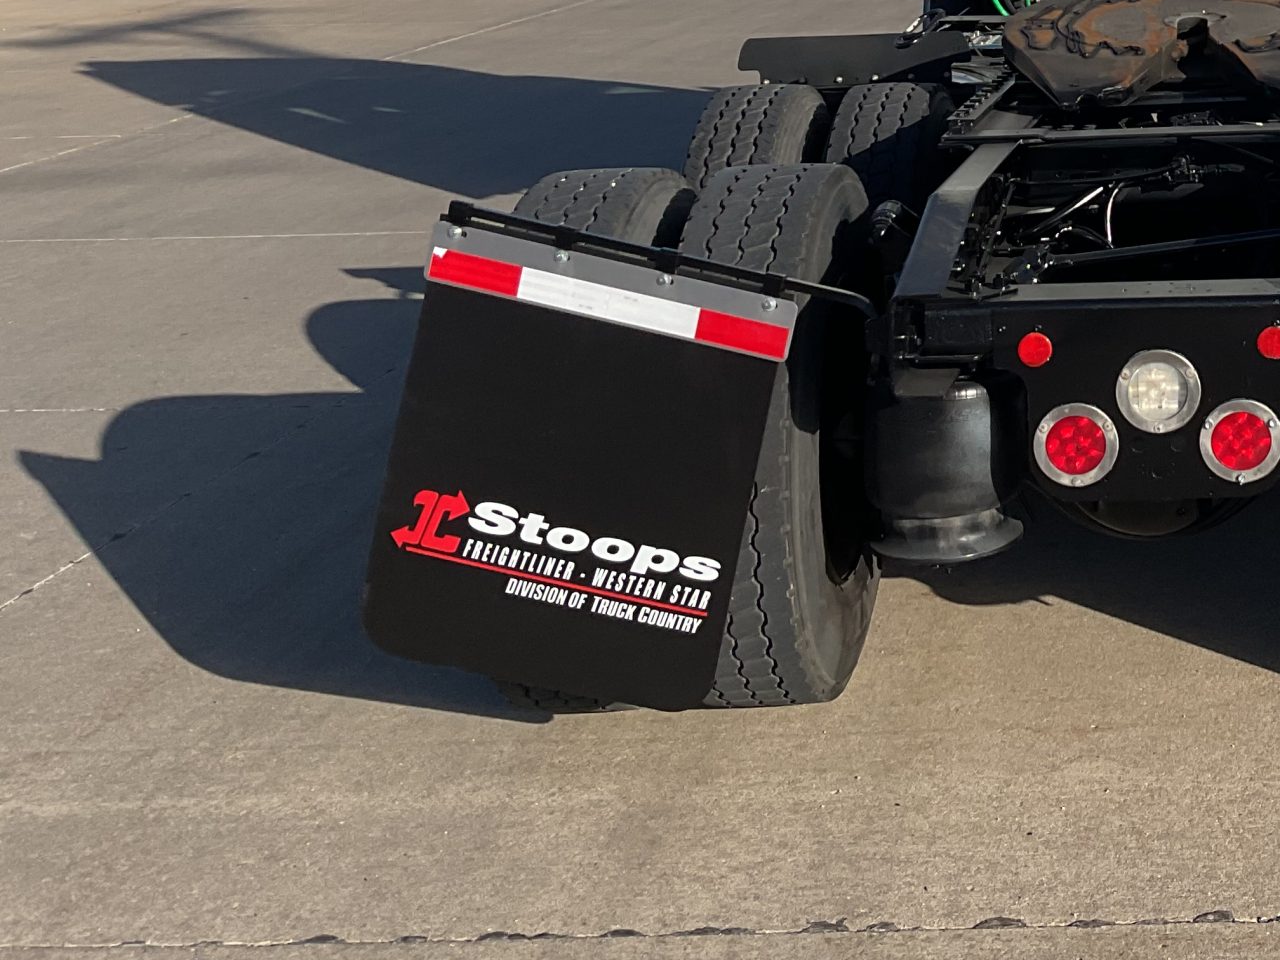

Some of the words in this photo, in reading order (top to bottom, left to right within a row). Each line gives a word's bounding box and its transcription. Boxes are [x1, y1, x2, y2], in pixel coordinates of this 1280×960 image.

[463, 539, 576, 580] FREIGHTLINER
[592, 568, 667, 601] WESTERN
[670, 586, 711, 610] STAR
[468, 502, 722, 581] Stoops
[505, 578, 567, 605] DIVISION
[568, 592, 586, 609] OF
[590, 596, 635, 620] TRUCK
[637, 606, 702, 634] COUNTRY
